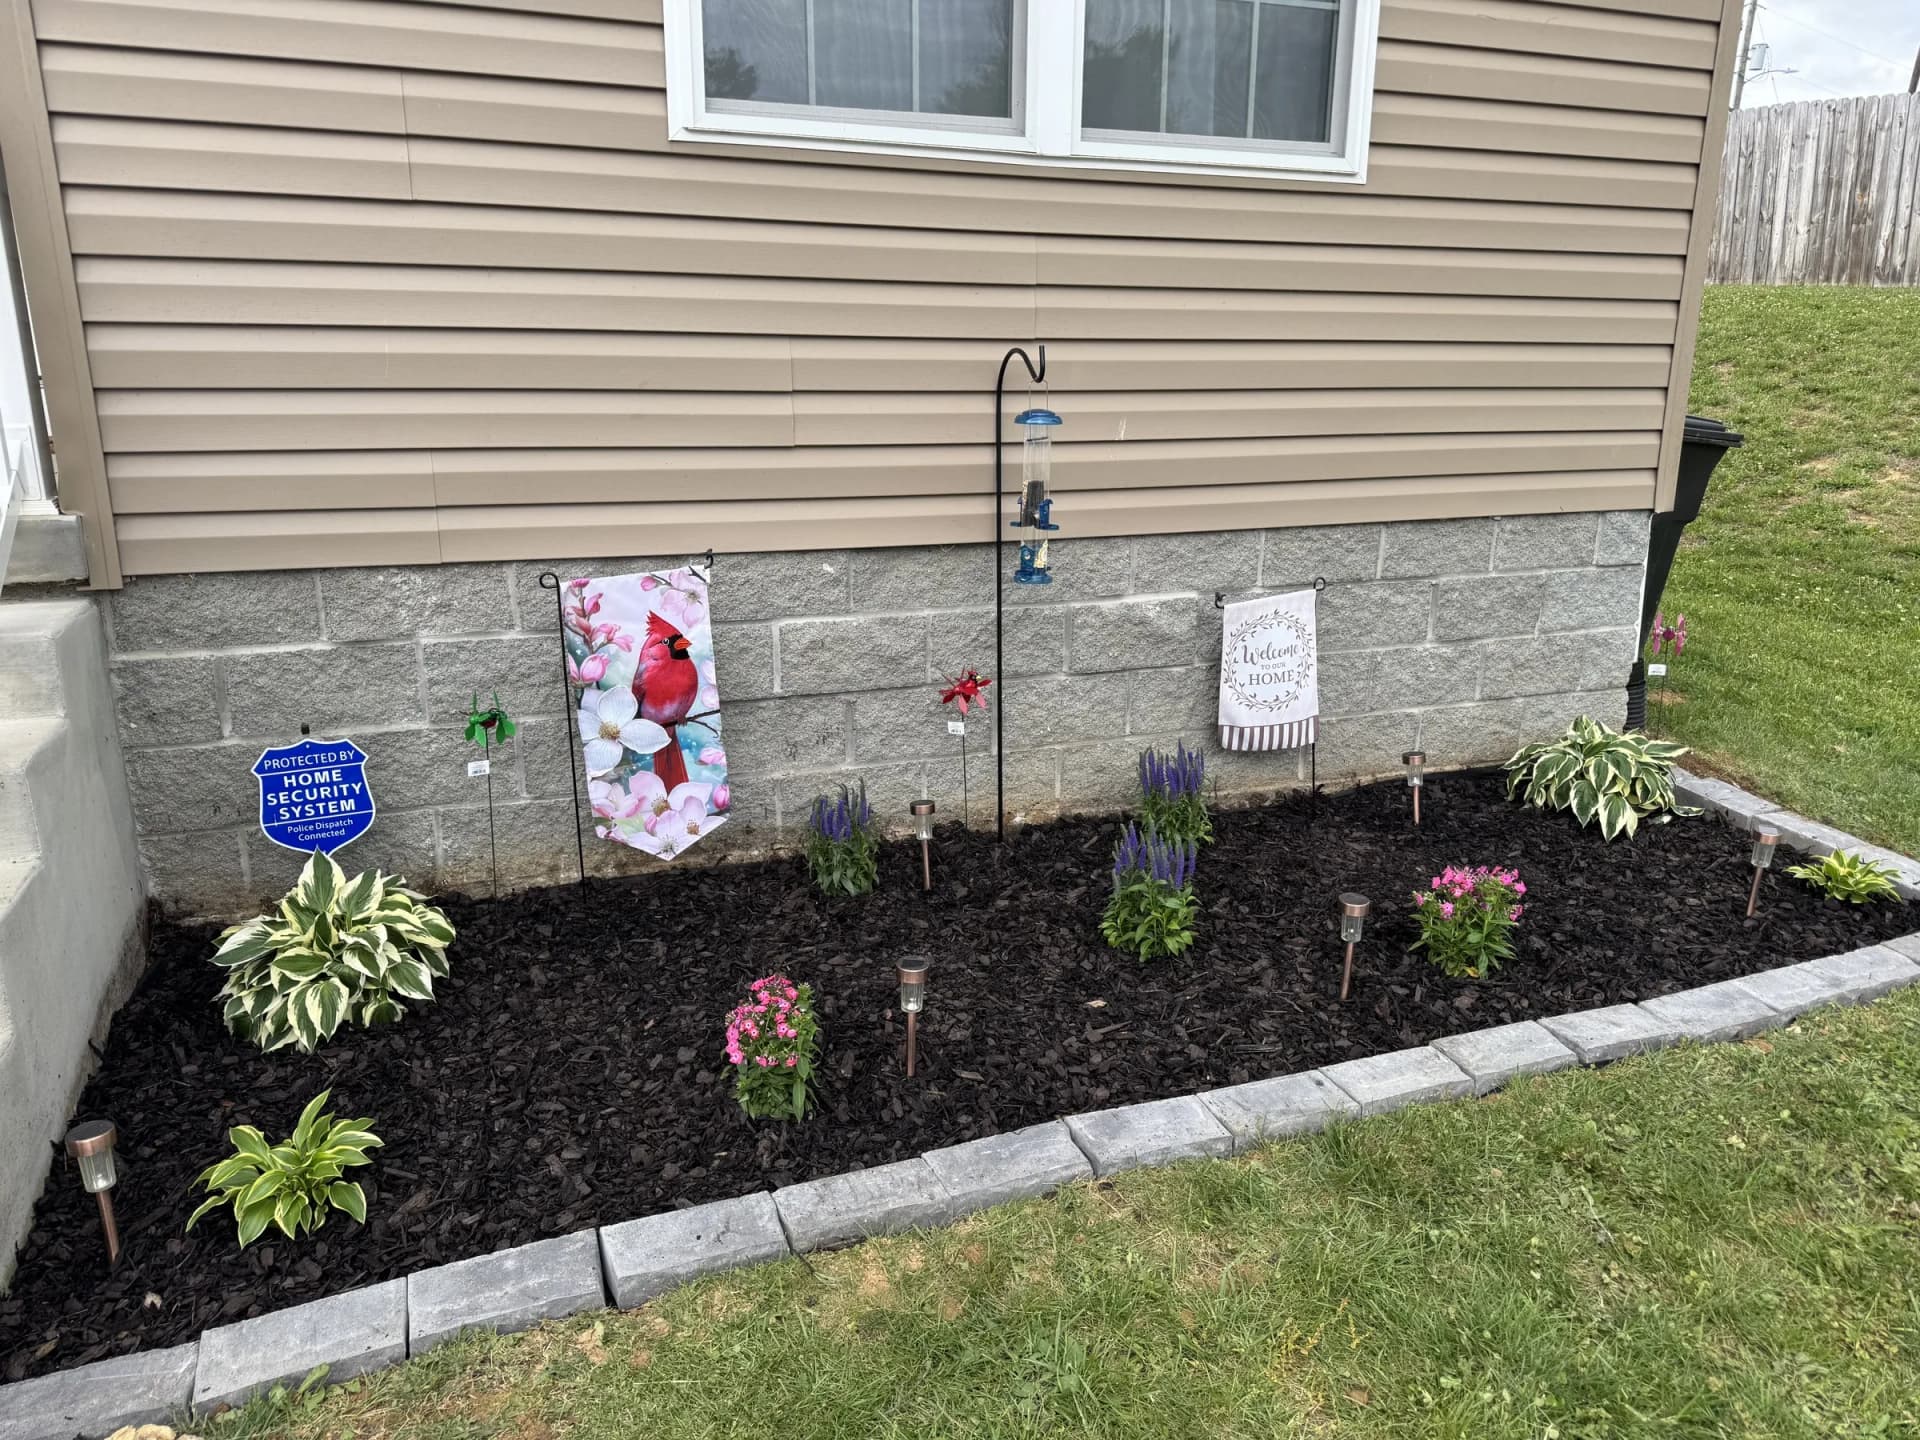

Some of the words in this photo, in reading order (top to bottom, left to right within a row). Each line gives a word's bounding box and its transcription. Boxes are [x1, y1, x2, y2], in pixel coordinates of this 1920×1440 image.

[1242, 641, 1298, 666] Welcome
[1272, 662, 1286, 670] OUR
[1248, 669, 1295, 686] HOME
[264, 752, 337, 770] PROTECTED
[339, 750, 355, 761] BY
[283, 769, 343, 788] HOME
[266, 782, 362, 806] SECURITY
[279, 798, 356, 820] SYSTEM
[287, 823, 314, 834] Police
[315, 818, 354, 830] Dispatch
[298, 828, 346, 841] Connected
